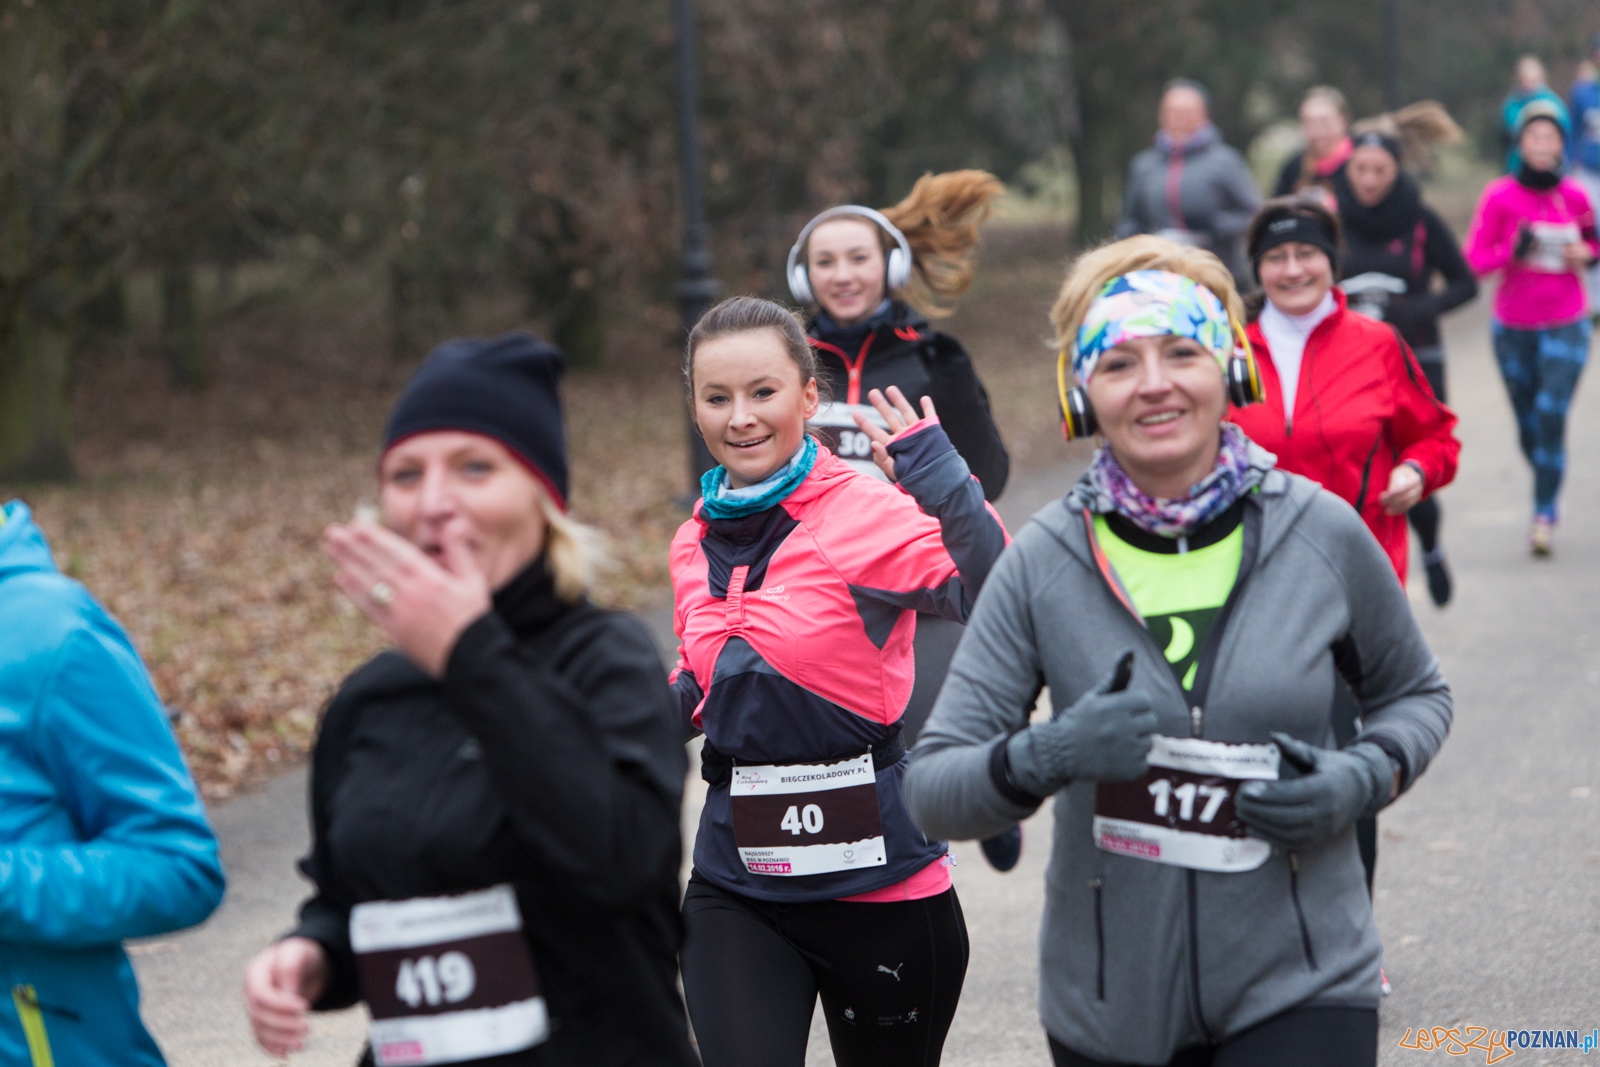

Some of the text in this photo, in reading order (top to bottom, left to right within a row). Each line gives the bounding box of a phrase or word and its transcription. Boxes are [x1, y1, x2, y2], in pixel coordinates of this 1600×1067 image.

[837, 430, 871, 457] 30
[780, 767, 867, 784] BIEGCZEKOLADOWY.PL
[1147, 778, 1230, 823] 117
[780, 803, 824, 835] 40
[395, 950, 476, 1009] 419
